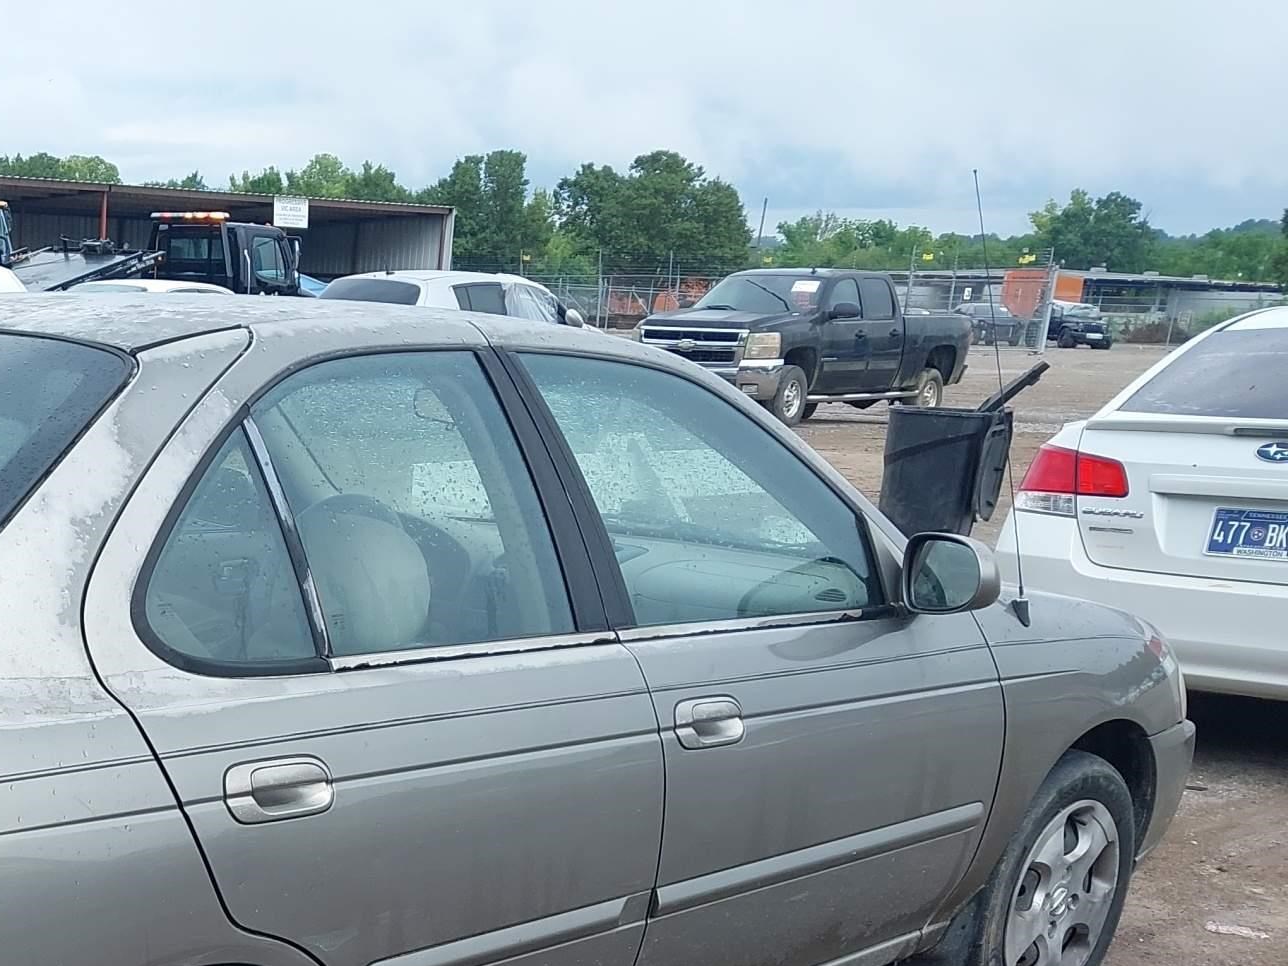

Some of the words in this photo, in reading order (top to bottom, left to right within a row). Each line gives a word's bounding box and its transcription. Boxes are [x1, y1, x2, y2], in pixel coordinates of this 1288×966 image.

[1081, 506, 1145, 520] SUBARU
[1249, 511, 1288, 521] TENNESSEE
[1213, 520, 1252, 545] 477
[1235, 548, 1284, 558] WASHINGTON
